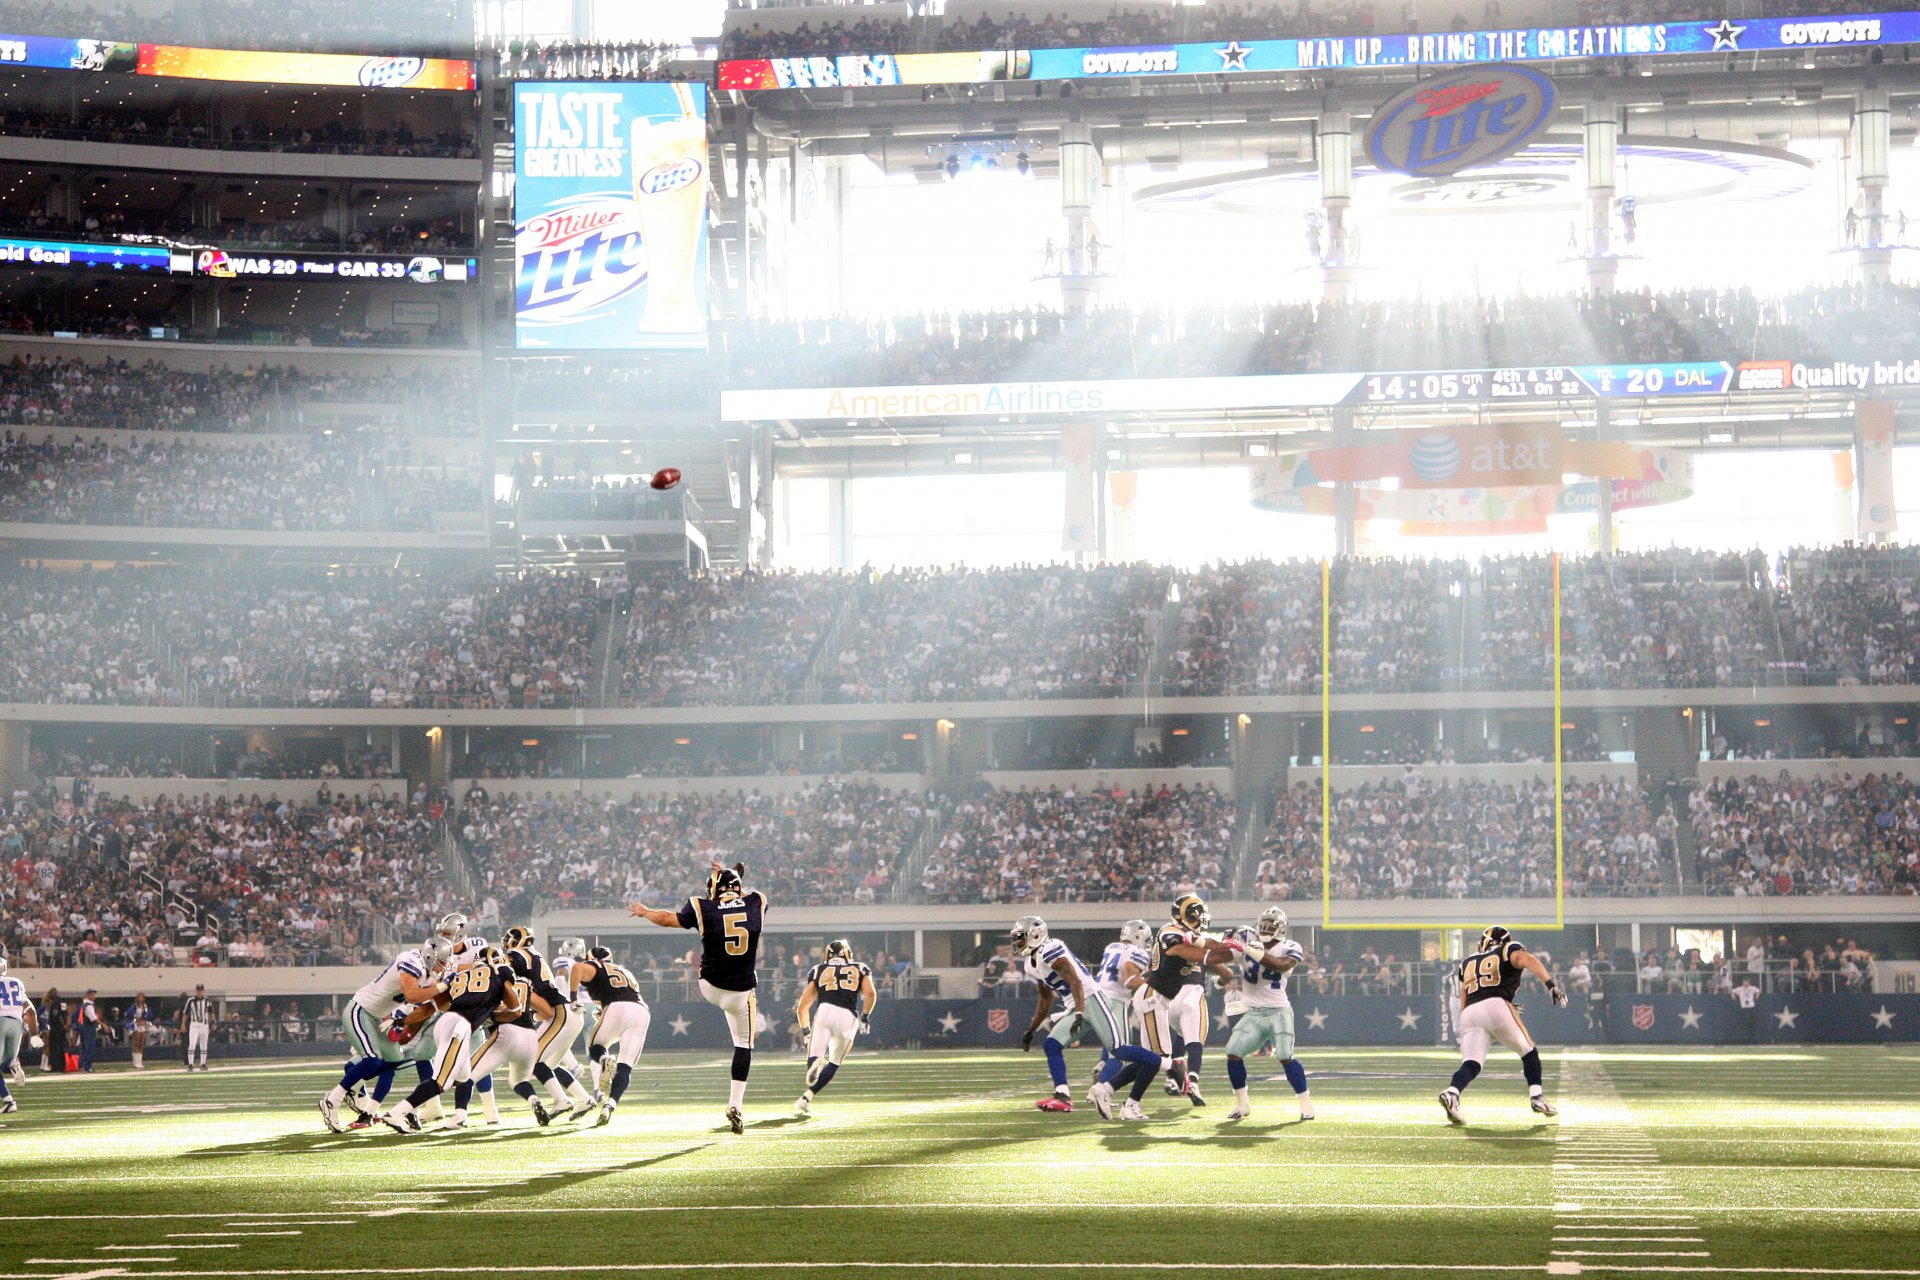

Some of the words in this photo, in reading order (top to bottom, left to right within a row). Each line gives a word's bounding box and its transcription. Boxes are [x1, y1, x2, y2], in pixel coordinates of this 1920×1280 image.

[1297, 40, 1344, 67] MAN
[1486, 31, 1527, 59] THE
[1538, 25, 1666, 57] GREATNESS
[1780, 20, 1880, 44] COWBOYS
[1083, 51, 1178, 73] COWBOYS
[1416, 81, 1502, 117] Miller
[519, 92, 623, 148] TASTE
[1406, 93, 1527, 170] Lite
[524, 147, 624, 178] GREATNESS
[528, 209, 624, 248] Miller
[29, 247, 71, 264] Goal
[228, 258, 271, 274] WAS
[272, 259, 297, 275] 20
[303, 262, 334, 274] Final
[338, 261, 379, 277] CAR
[381, 262, 405, 278] 33
[516, 231, 642, 313] Lite
[1368, 375, 1458, 400] 14:05
[1462, 374, 1483, 385] QTR
[1534, 382, 1553, 395] On
[1561, 381, 1579, 394] 32
[1545, 368, 1563, 381] 10
[1627, 369, 1663, 392] 20
[1674, 370, 1712, 386] DAL
[1792, 361, 1870, 389] Quality
[1467, 383, 1478, 397] 4
[1472, 438, 1551, 473] at&t
[723, 912, 749, 955] 5
[449, 966, 491, 1000] 88
[818, 966, 860, 991] 43
[1463, 954, 1501, 994] 49
